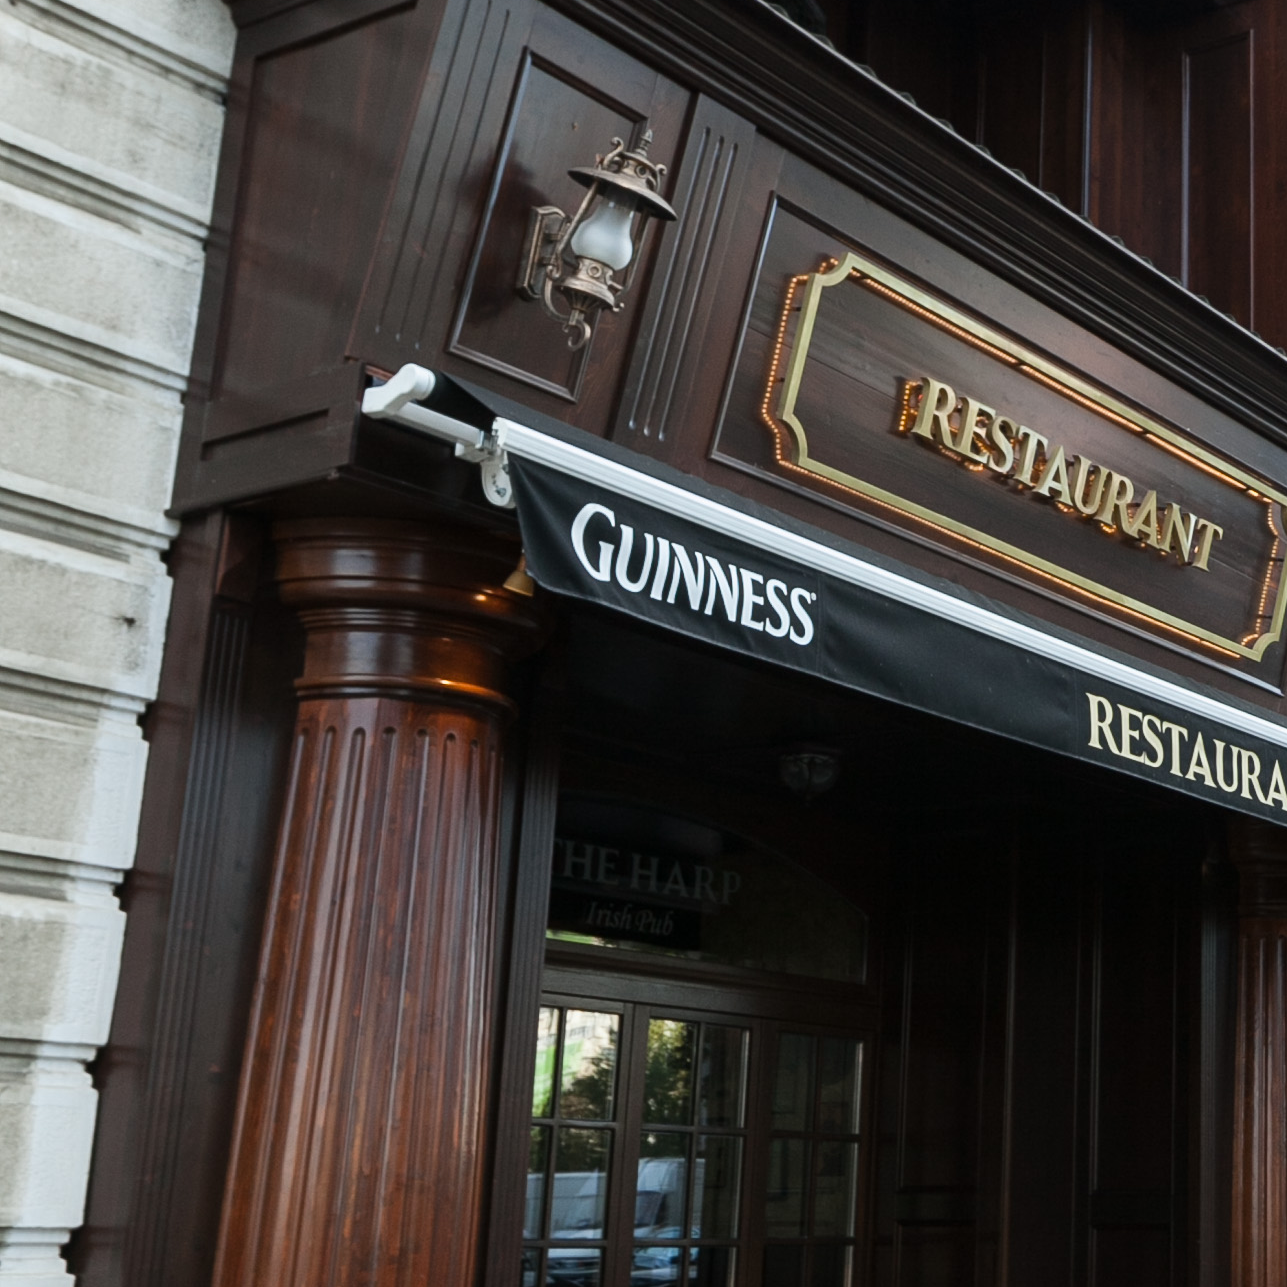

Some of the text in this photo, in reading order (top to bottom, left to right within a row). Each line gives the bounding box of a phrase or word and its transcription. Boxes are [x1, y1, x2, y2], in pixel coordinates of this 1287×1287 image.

[911, 376, 1224, 573] RESTAURANT
[571, 501, 815, 646] GUINNESS
[585, 900, 675, 937] Irish Pub
[629, 852, 742, 906] HARP
